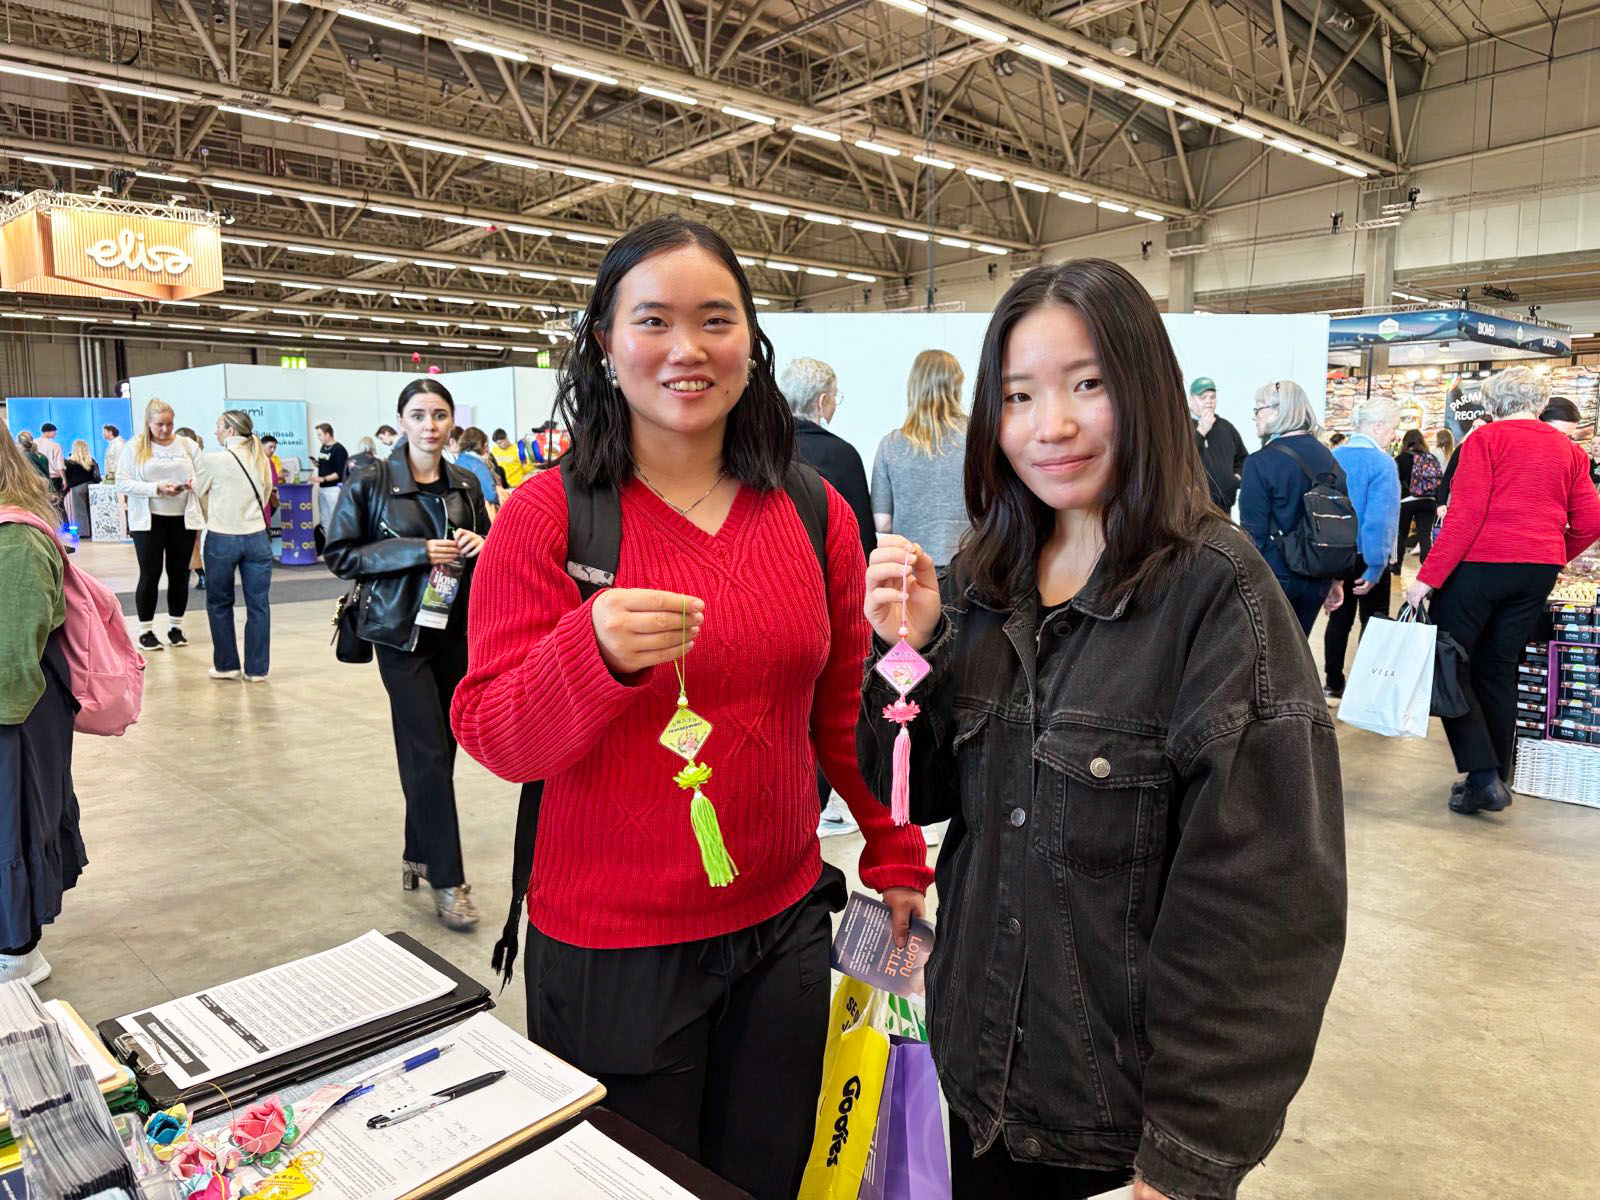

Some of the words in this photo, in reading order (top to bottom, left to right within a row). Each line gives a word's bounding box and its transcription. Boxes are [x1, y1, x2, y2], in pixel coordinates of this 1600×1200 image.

[85, 228, 193, 274] elisa
[1478, 322, 1496, 337] BIOMED
[1372, 667, 1395, 677] VILA
[884, 946, 904, 977] :LLE
[900, 935, 922, 978] LOPPU
[826, 1075, 861, 1168] Goodies
